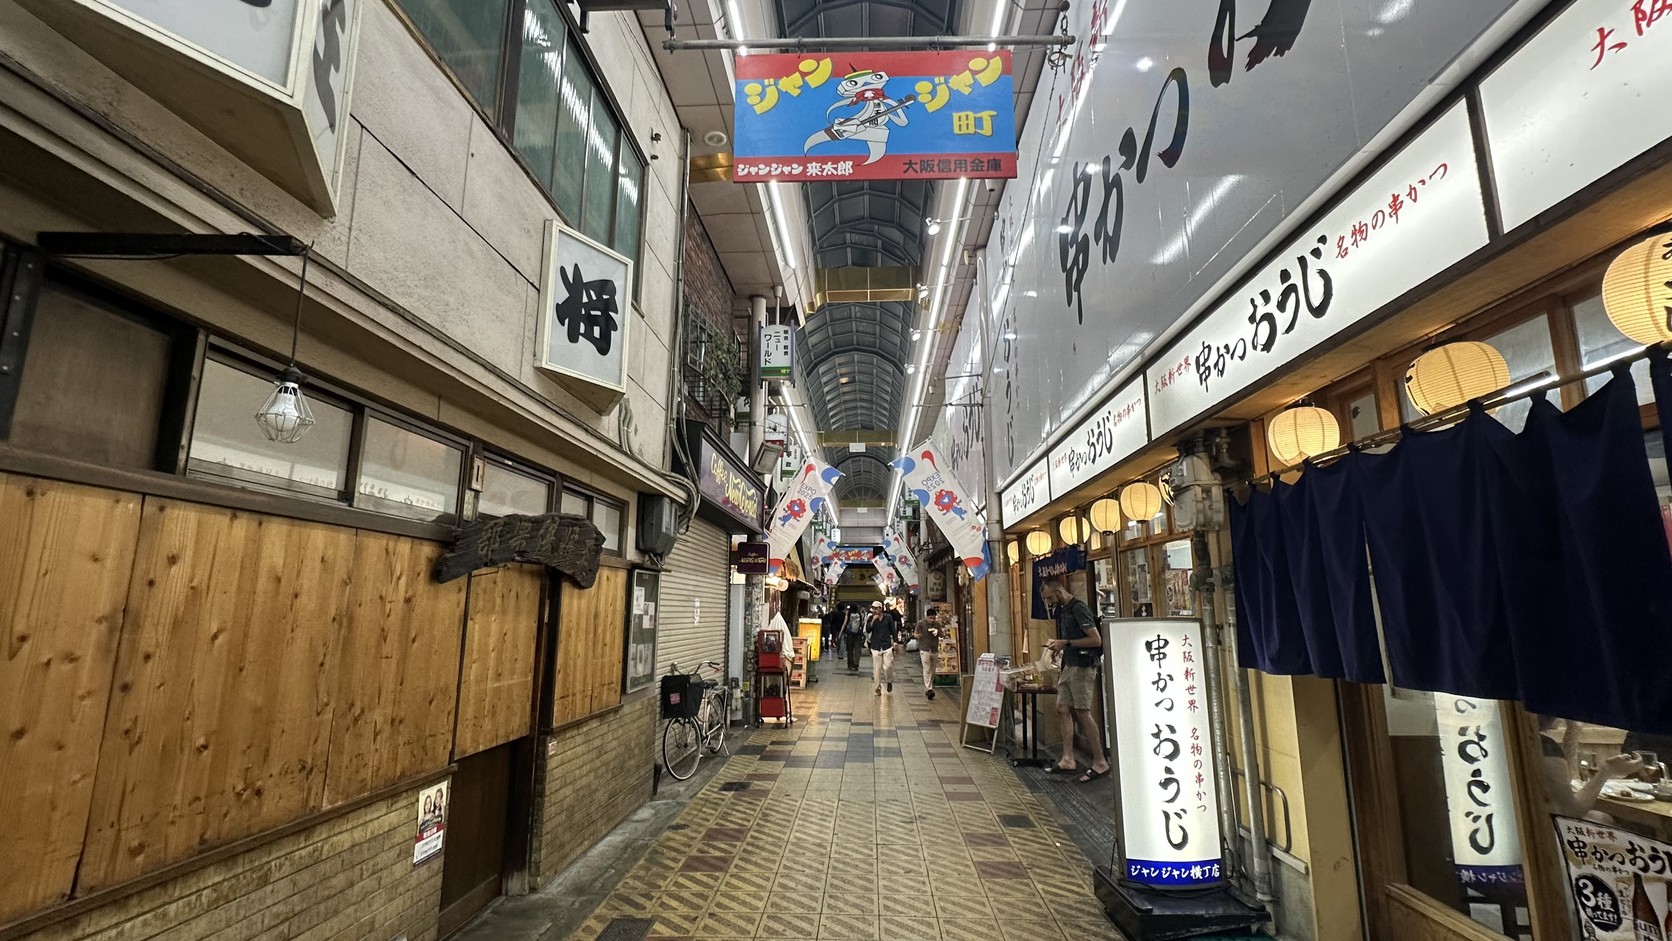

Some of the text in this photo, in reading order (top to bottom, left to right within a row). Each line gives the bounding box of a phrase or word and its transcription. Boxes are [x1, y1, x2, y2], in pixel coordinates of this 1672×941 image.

[744, 57, 832, 115] ジャン
[914, 56, 1003, 113] ジャン
[953, 110, 998, 136] 町
[737, 160, 854, 176] ジャンジャン 来太郎
[903, 158, 1003, 174] 大阪信用金庫
[1336, 162, 1449, 259] 名物の串かつ
[1195, 235, 1334, 393] 串かつおうじ
[764, 334, 772, 366] ワールド
[773, 331, 781, 351] ニュー
[1154, 355, 1191, 395] 大阪新世界
[1068, 410, 1113, 478] 串かつおうじ
[711, 452, 728, 485] Coffee
[797, 489, 813, 501] 2025
[800, 483, 817, 495] EXPO
[1181, 634, 1207, 813] 大阪新世界 名物の串かつ
[1145, 634, 1189, 850] 串かつおうじ
[1567, 825, 1618, 842] 大阪新世界
